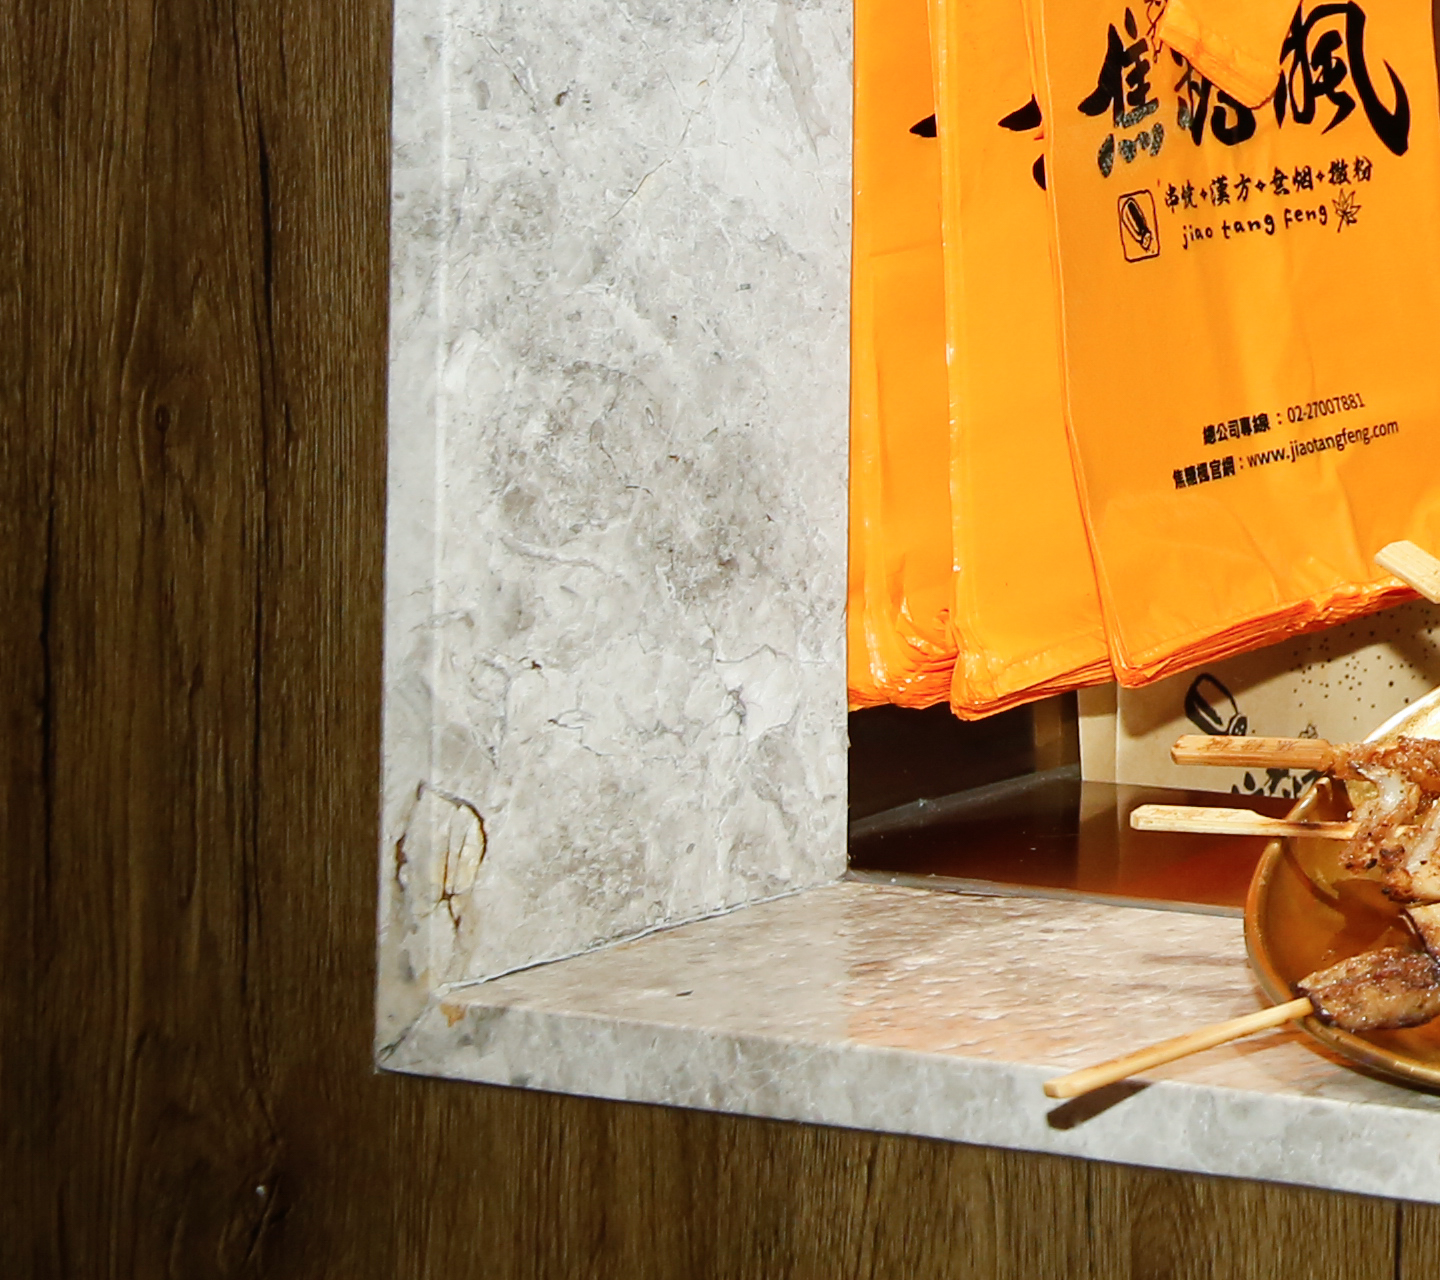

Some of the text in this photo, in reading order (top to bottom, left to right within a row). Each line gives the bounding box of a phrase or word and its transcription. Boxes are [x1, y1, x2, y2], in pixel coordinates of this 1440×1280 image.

[1182, 224, 1213, 250] jiao
[1221, 214, 1275, 239] tang
[1287, 392, 1366, 424] 02-27007881
[1246, 419, 1400, 469] www.jiaotangfeng.com
